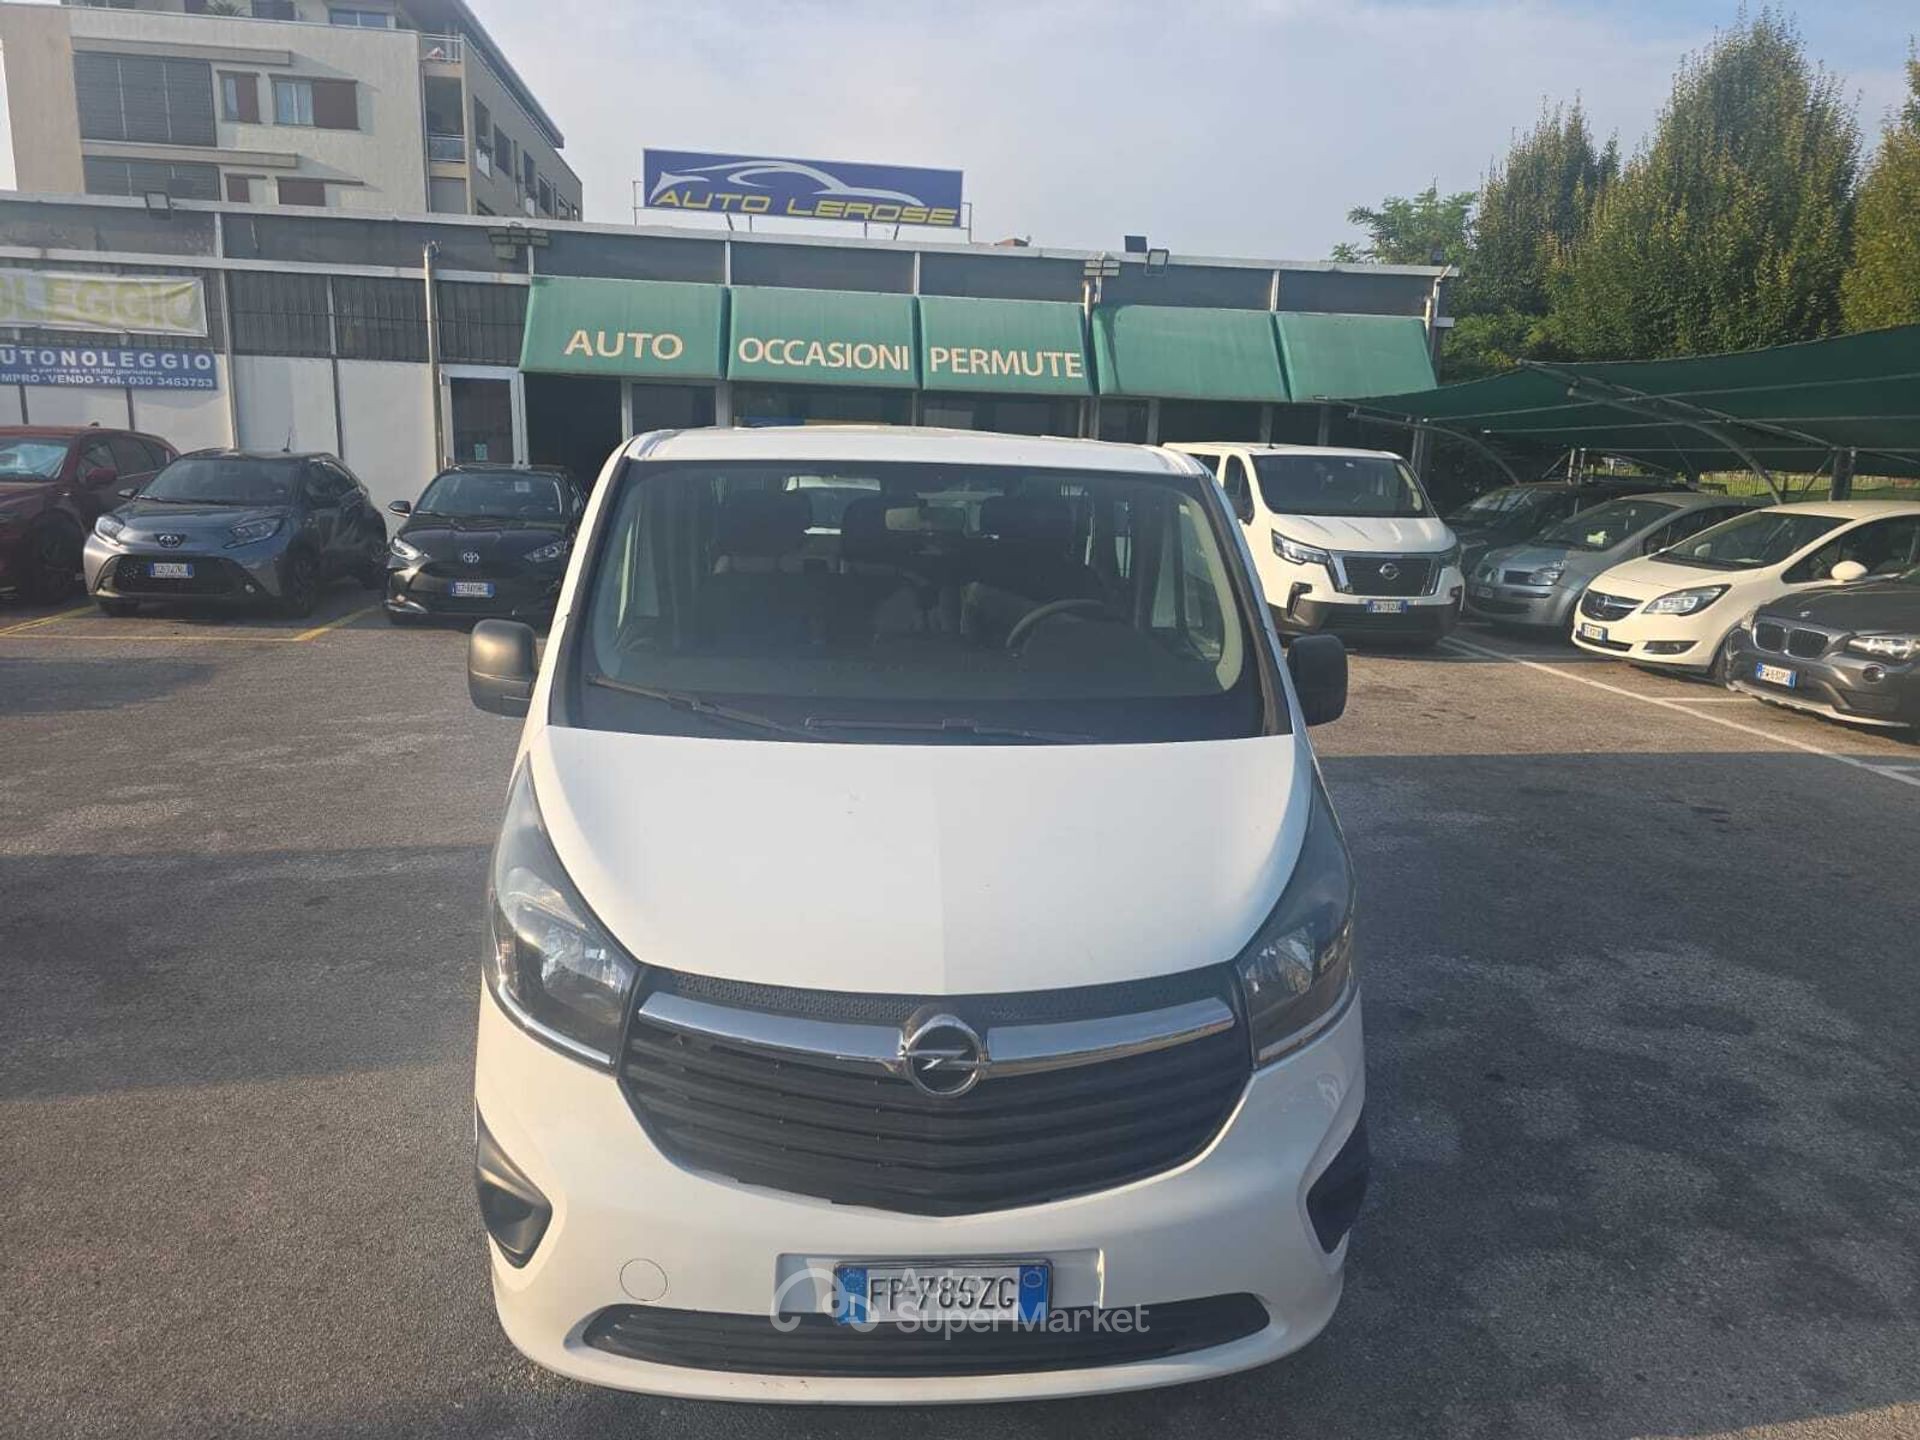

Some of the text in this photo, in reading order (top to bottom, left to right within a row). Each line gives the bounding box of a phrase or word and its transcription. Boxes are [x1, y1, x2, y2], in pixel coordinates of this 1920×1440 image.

[654, 190, 958, 225] AUTO LEROSE
[0, 349, 211, 369] UTONOLEGGIO
[564, 329, 684, 361] AUTO
[738, 336, 911, 371] OCCASIONI
[929, 347, 1084, 379] PERMUTE
[47, 374, 94, 384] VENDO
[101, 375, 125, 385] Tel.
[128, 375, 153, 386] 030
